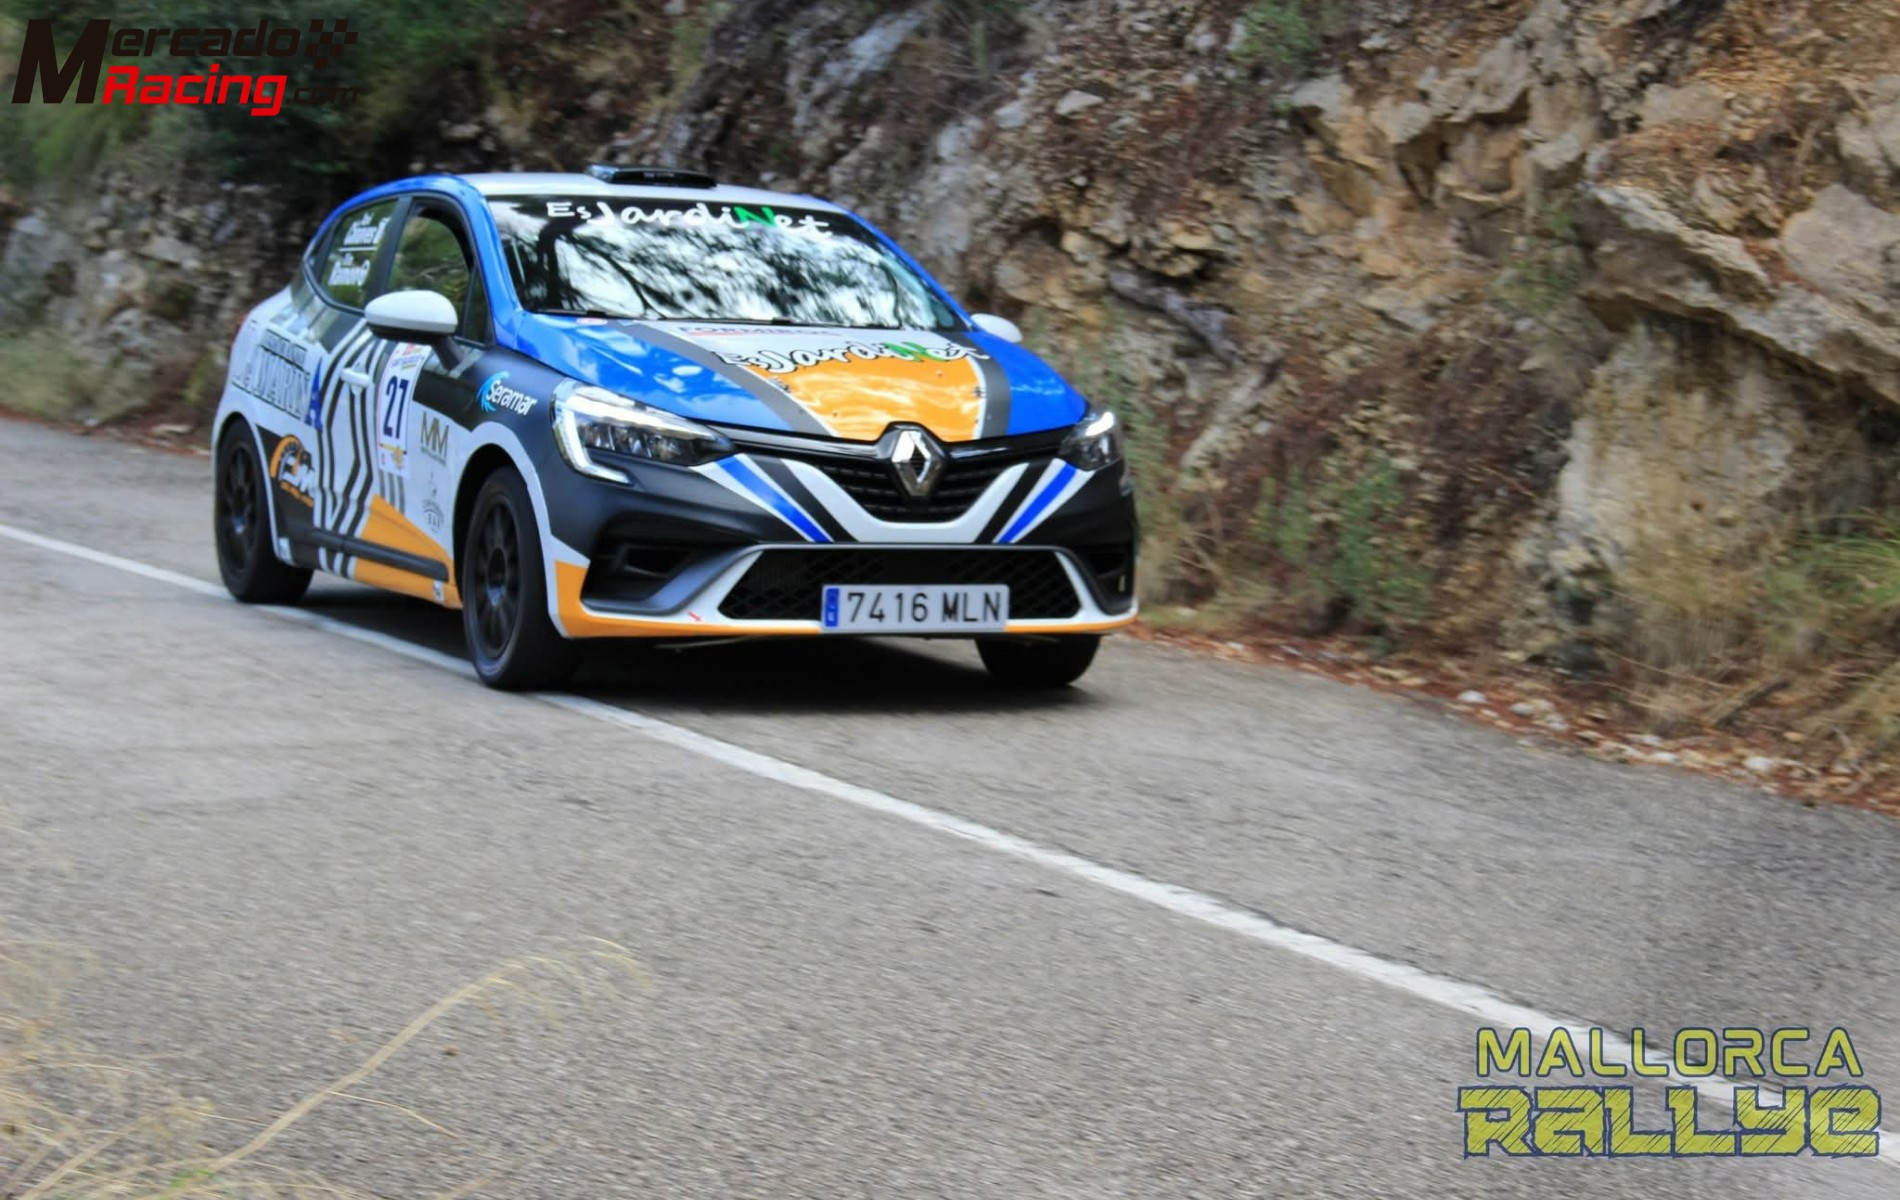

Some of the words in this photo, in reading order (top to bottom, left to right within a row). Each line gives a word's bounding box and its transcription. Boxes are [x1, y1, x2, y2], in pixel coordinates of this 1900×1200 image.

[383, 375, 409, 439] 27
[486, 379, 538, 416] Seramar
[847, 592, 928, 622] 7416
[942, 592, 1001, 622] MLN
